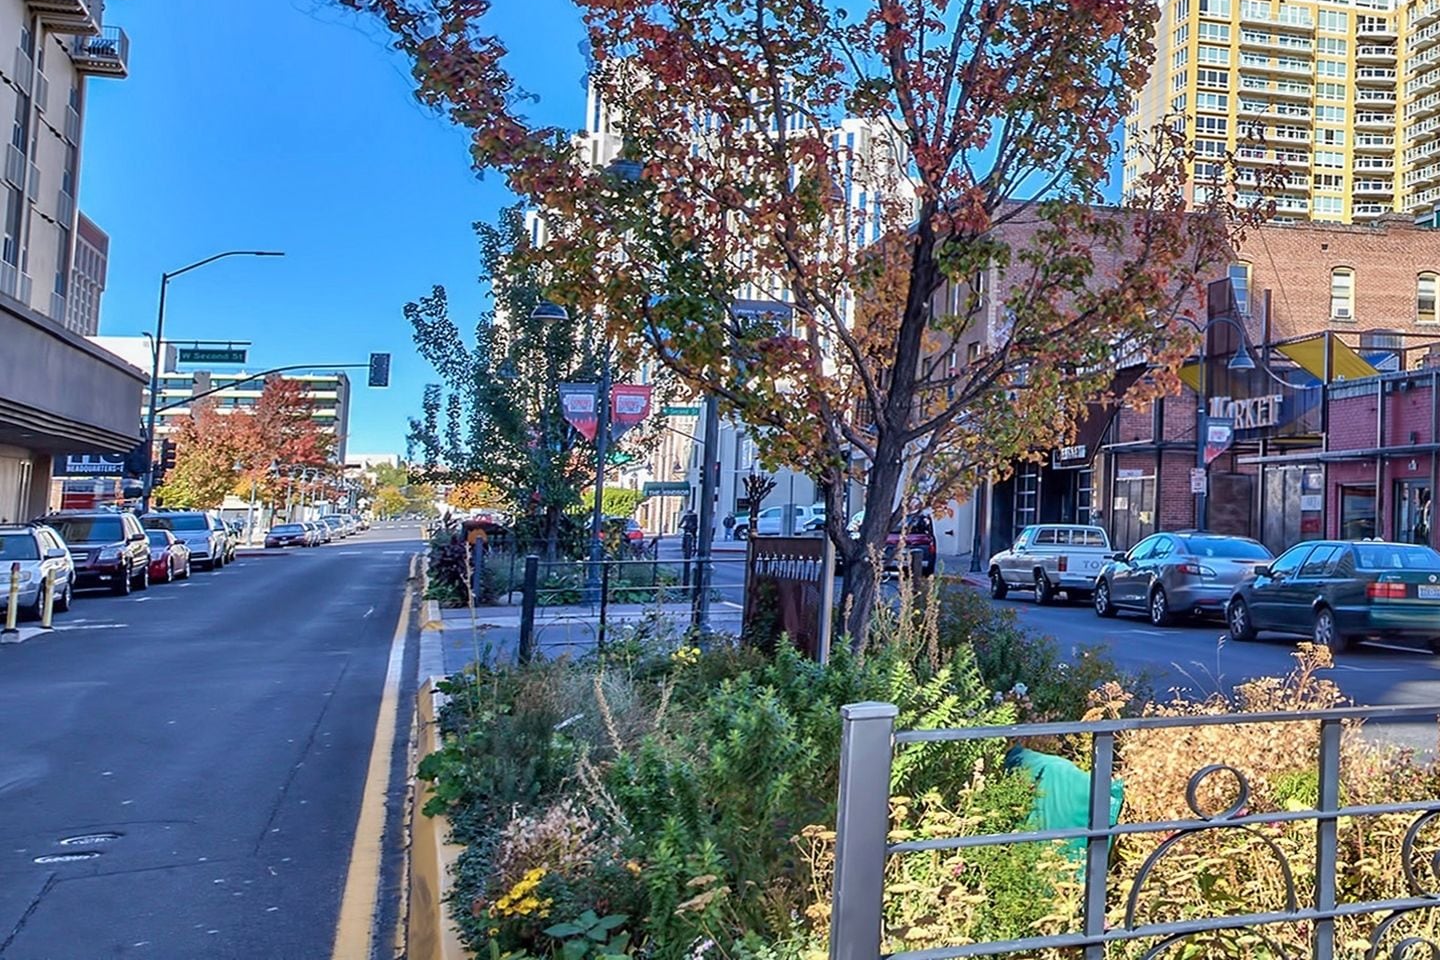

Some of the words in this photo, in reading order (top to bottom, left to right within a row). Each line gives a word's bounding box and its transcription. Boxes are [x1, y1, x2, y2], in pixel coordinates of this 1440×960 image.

[182, 352, 192, 360] W
[193, 352, 230, 360] Second
[232, 352, 244, 360] St
[1208, 394, 1283, 429] MARKET
